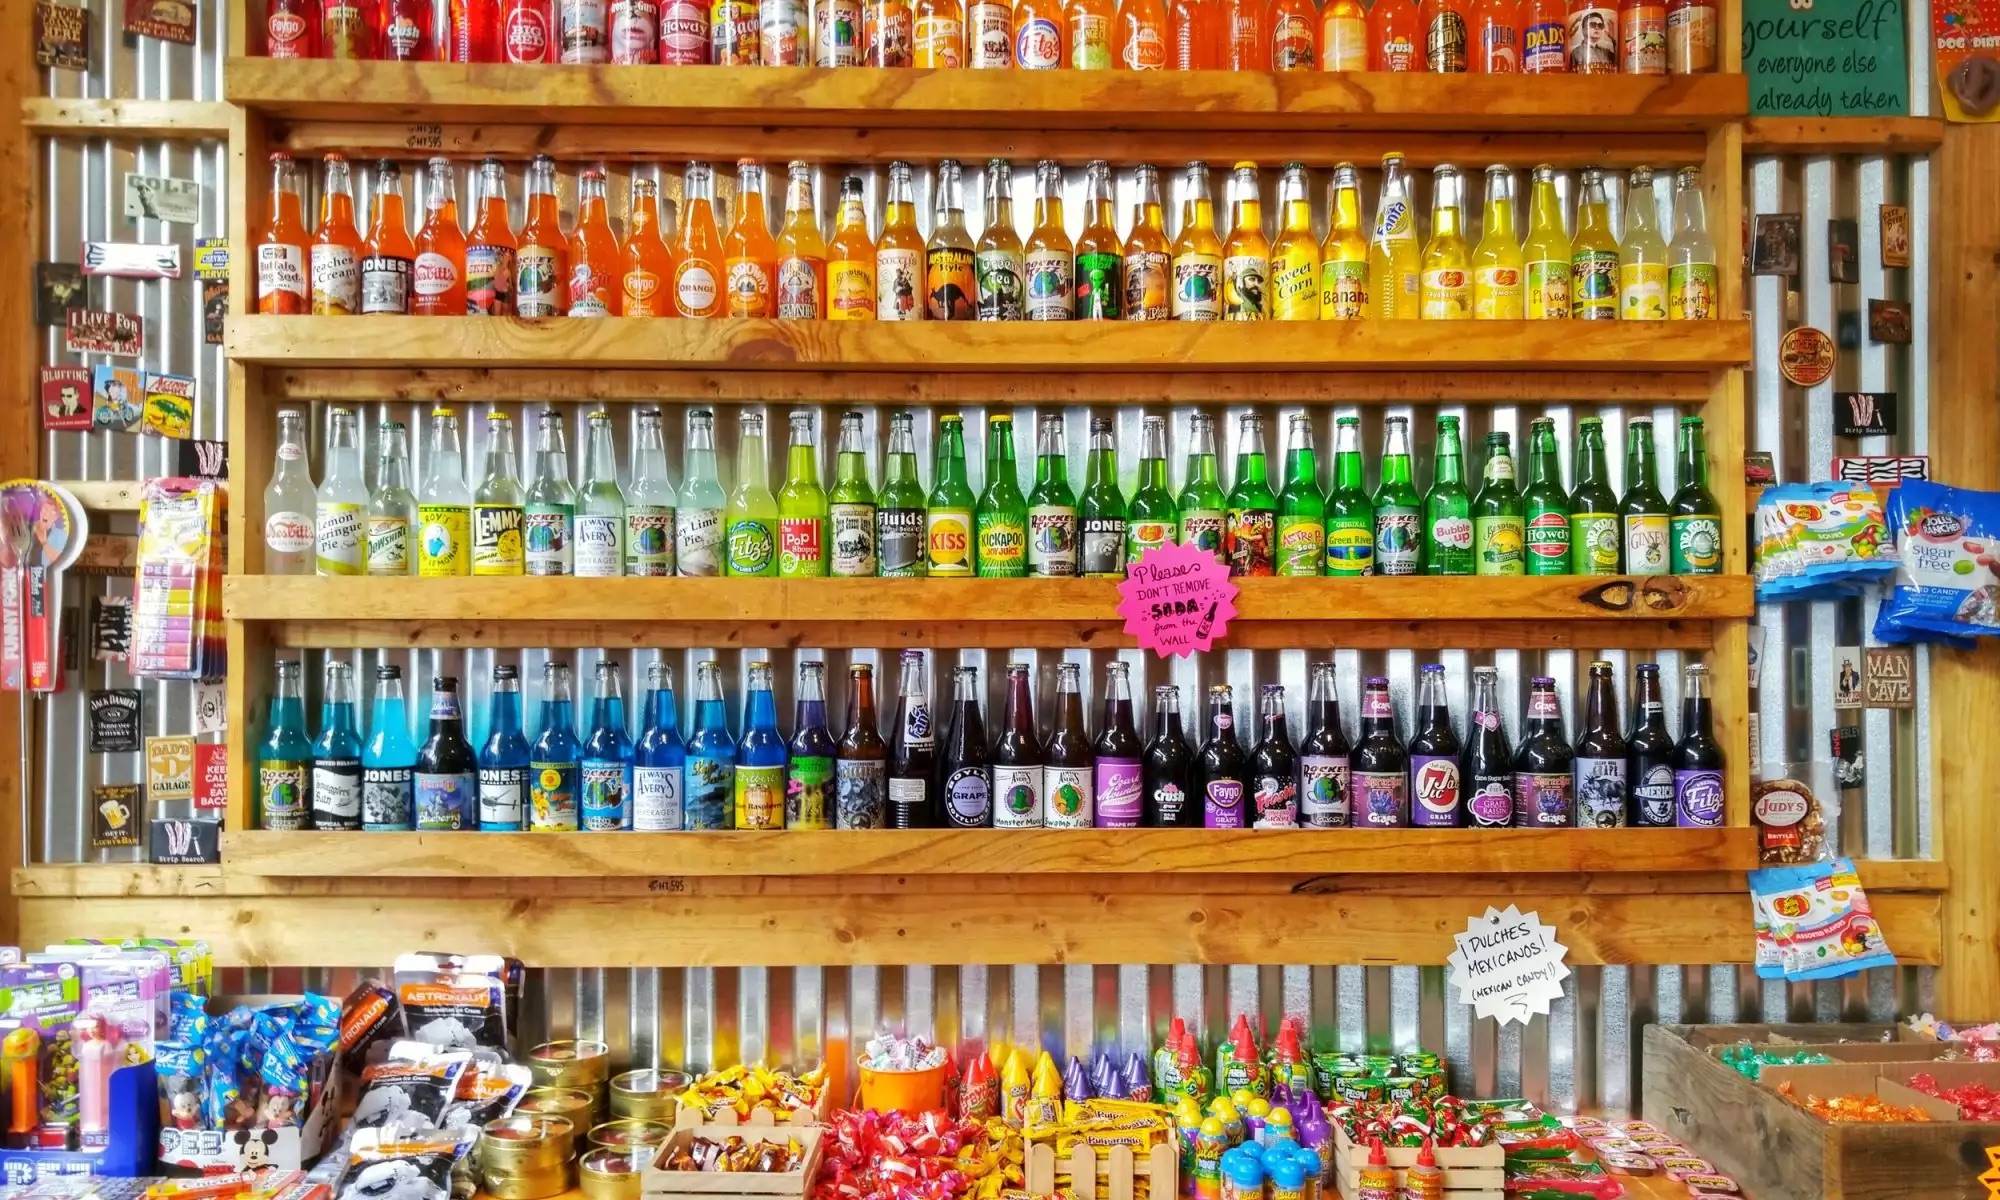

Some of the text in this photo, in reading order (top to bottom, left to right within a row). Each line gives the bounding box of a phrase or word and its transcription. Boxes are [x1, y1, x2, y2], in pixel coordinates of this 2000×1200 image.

[662, 21, 707, 37] Howdy
[1526, 26, 1565, 49] DAD'S
[1937, 37, 1965, 50] DOG
[1757, 51, 1876, 83] everyone else
[1757, 87, 1900, 117] already taken
[128, 175, 196, 195] GOLF
[1377, 201, 1407, 236] Fanta
[205, 239, 229, 247] SUPE
[200, 270, 229, 279] SERVIC
[318, 267, 356, 284] Cream
[940, 263, 964, 273] Style
[1274, 262, 1312, 288] Sweet
[627, 278, 654, 291] Faygo
[990, 272, 1010, 286] Tea
[679, 284, 714, 294] ORANGE
[1278, 277, 1313, 301] Corn
[1323, 289, 1369, 306] Banana
[81, 311, 110, 328] LIVE
[115, 312, 138, 333] FOR
[318, 512, 354, 530] Lemon
[691, 516, 718, 532] Lime
[878, 511, 924, 527] Fluids
[1084, 519, 1126, 533] JONES
[1926, 513, 1953, 525] JOLLY
[787, 531, 809, 545] Pop
[1435, 523, 1470, 538] Bubble
[1453, 531, 1470, 545] up
[1526, 529, 1570, 544] Howdy
[731, 532, 772, 559] Fitz's
[930, 532, 966, 551] KISS
[981, 531, 1023, 549] KICKAPOO
[1282, 530, 1314, 547] ASTRO
[1329, 533, 1373, 545] Green River
[320, 540, 338, 553] Pie
[792, 545, 817, 555] Shoppe
[986, 546, 1019, 557] JOY JUICE
[1912, 545, 1955, 562] sugar
[1918, 557, 1951, 571] free
[1133, 562, 1202, 585] Please
[1136, 577, 1213, 601] DON'T REMOVE
[1931, 586, 1960, 595] CANDY
[1151, 598, 1200, 619] SODA
[1153, 619, 1198, 636] from the
[1159, 635, 1191, 648] WALL
[1867, 655, 1911, 678] MAN
[1866, 679, 1911, 702] CAVE
[363, 769, 411, 782] JONES
[1303, 764, 1348, 780] ROCKET
[1593, 765, 1618, 777] GRAPE
[152, 781, 191, 792] GARAGE
[209, 788, 228, 796] EAT
[1213, 784, 1240, 799] Faygo
[952, 790, 987, 801] GRAPE
[1153, 789, 1184, 803] Crush
[1686, 786, 1724, 811] Fitz's
[1483, 800, 1506, 808] GRAPE
[1483, 806, 1507, 814] RAISIN
[1758, 798, 1803, 817] JUDY'S
[1044, 817, 1072, 829] Swamp
[1215, 816, 1238, 824] GRAPE
[1316, 815, 1343, 824] GRAPE
[1367, 812, 1398, 826] Grape
[1538, 812, 1566, 825] Grape
[1690, 814, 1713, 826] GRAPE
[1467, 933, 1548, 979] MEXICANOS!
[1471, 961, 1556, 1002] (MEXICAN CANDY!)
[407, 992, 487, 1003] ASTRONAUT
[160, 1126, 223, 1155] PEZ
